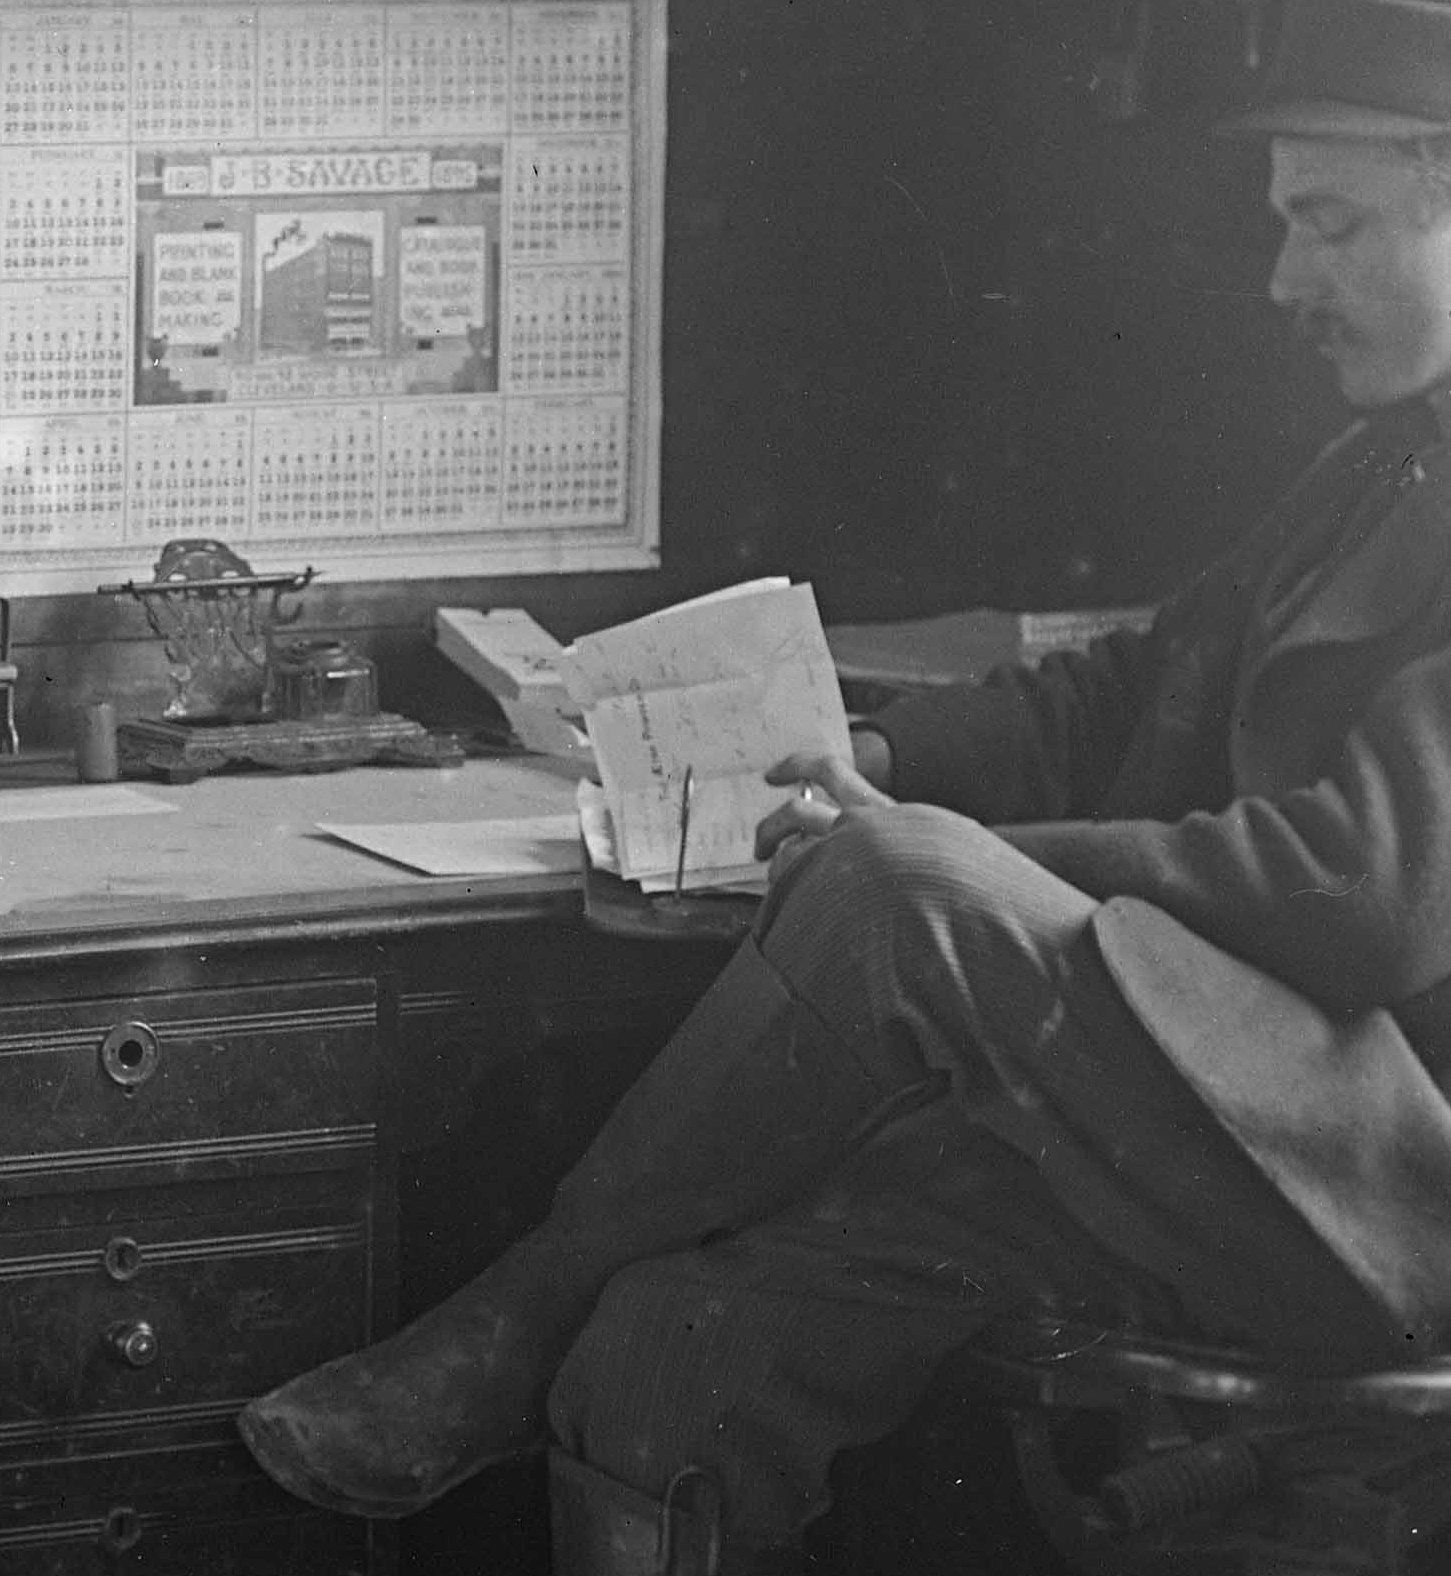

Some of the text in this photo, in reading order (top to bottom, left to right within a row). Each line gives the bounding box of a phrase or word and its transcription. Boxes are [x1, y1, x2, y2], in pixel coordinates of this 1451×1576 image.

[287, 158, 421, 188] SAVAGE
[161, 243, 235, 259] PRINTING
[159, 289, 204, 306] BOOK
[158, 311, 224, 327] MAKING
